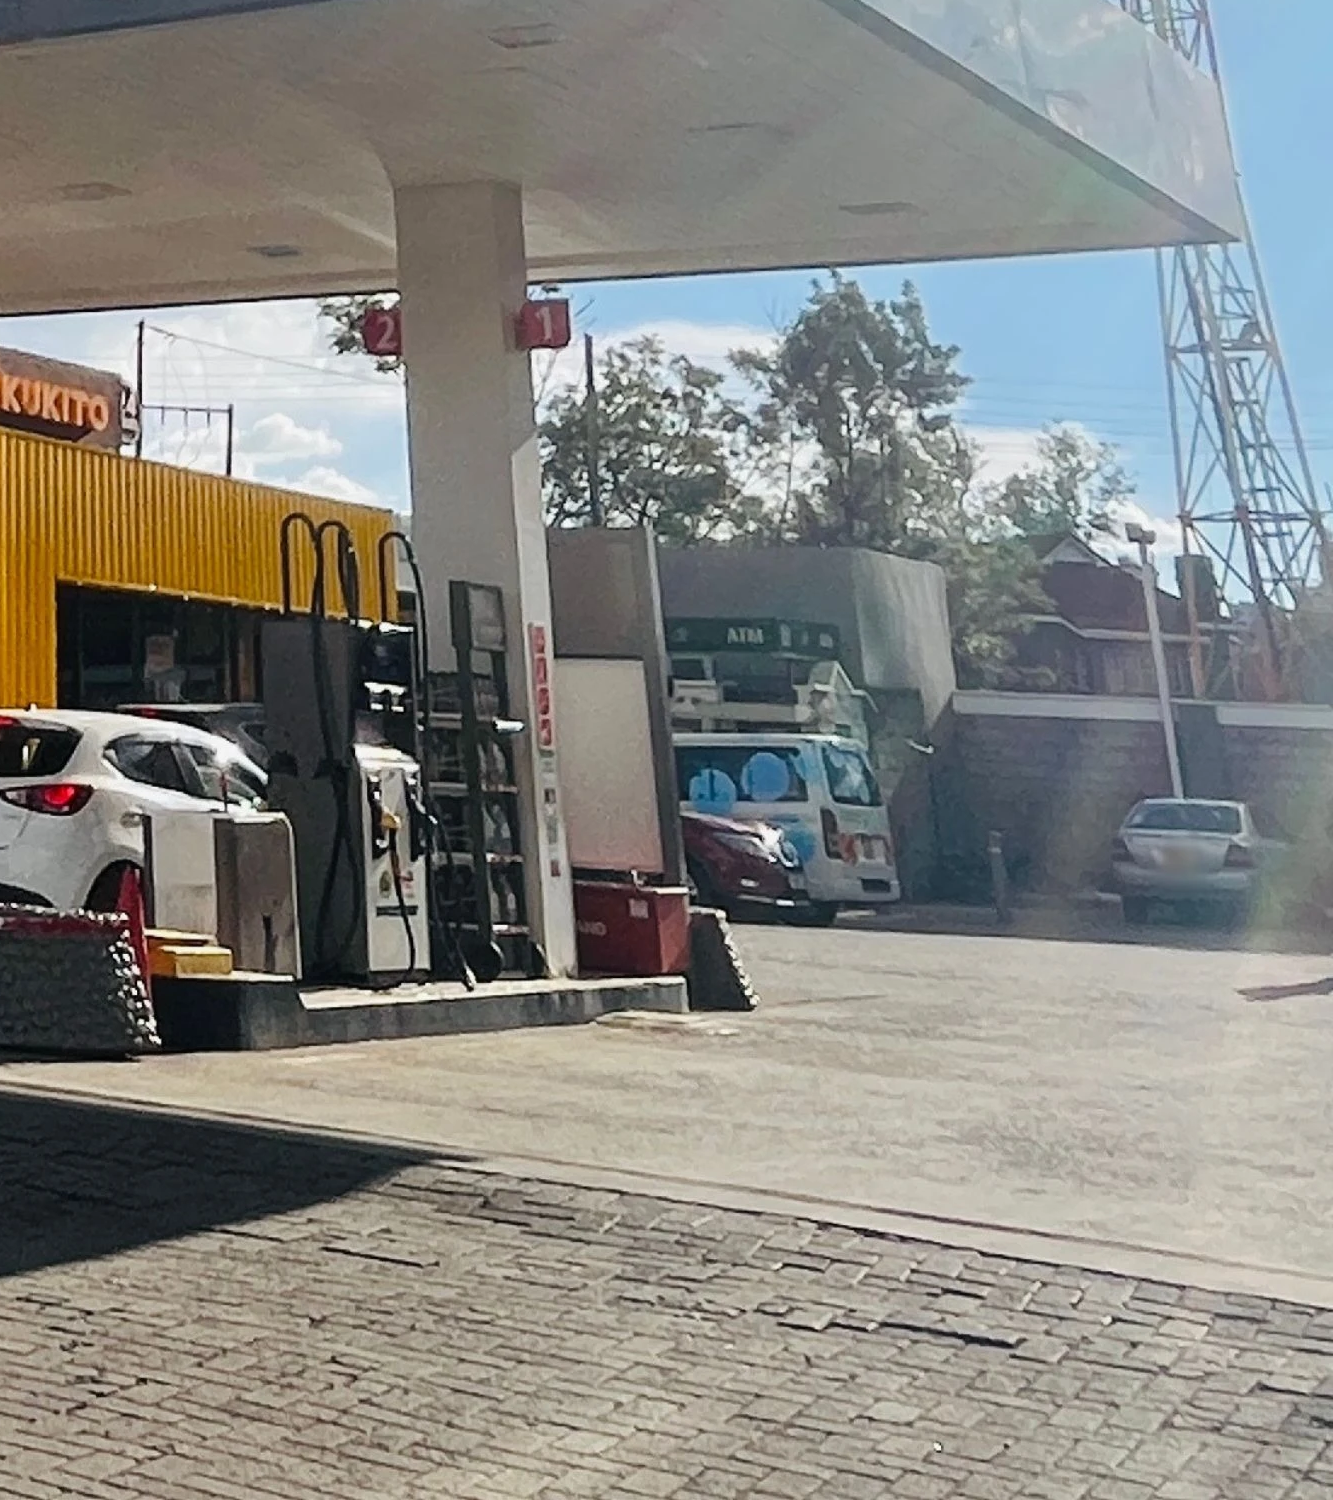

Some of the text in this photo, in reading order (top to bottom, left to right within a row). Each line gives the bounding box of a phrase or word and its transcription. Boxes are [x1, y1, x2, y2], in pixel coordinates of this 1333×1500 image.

[376, 315, 398, 350] 2
[536, 306, 553, 342] 1
[0, 374, 109, 432] KUKITO
